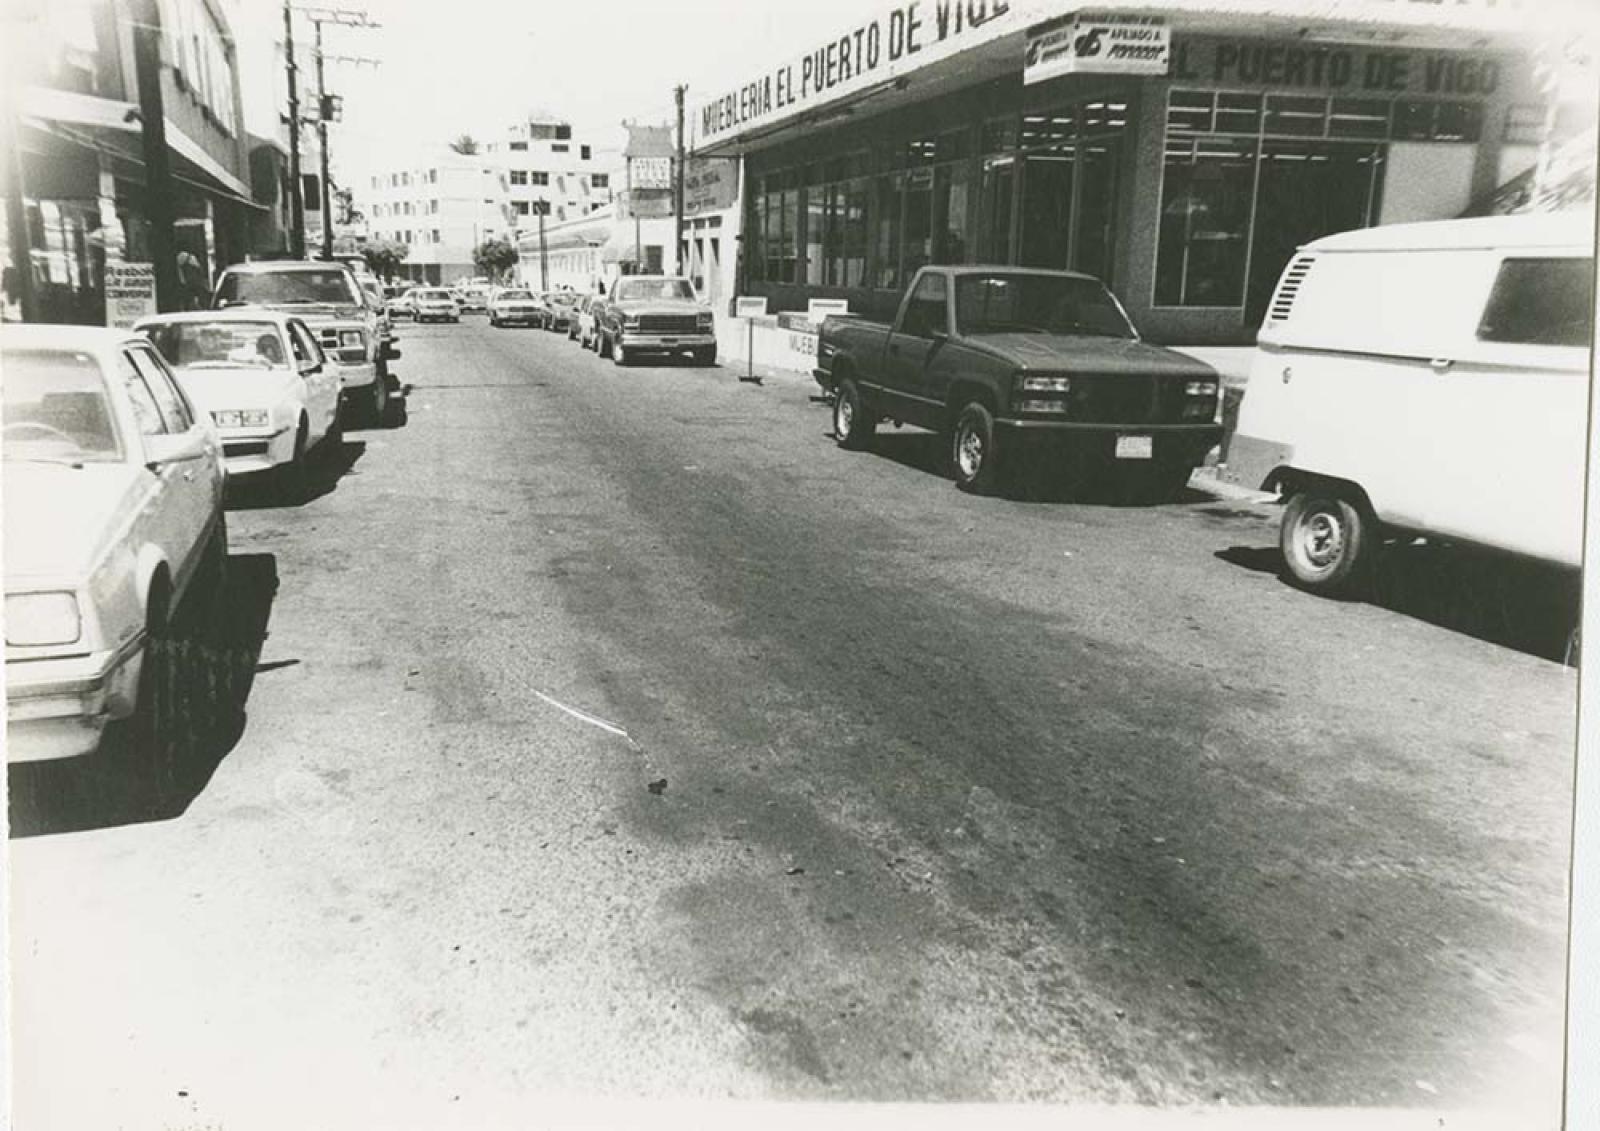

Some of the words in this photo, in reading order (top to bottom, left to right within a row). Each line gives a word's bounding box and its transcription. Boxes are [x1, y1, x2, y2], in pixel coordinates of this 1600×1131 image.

[702, 75, 770, 138] MUEBLERIA
[775, 65, 796, 108] EL
[801, 19, 880, 98] PUERTO
[888, 3, 921, 61] DE
[935, 0, 1009, 41] VI
[1214, 43, 1349, 87] PUERTO
[1360, 52, 1406, 92] DE
[1424, 54, 1499, 96] VIGO
